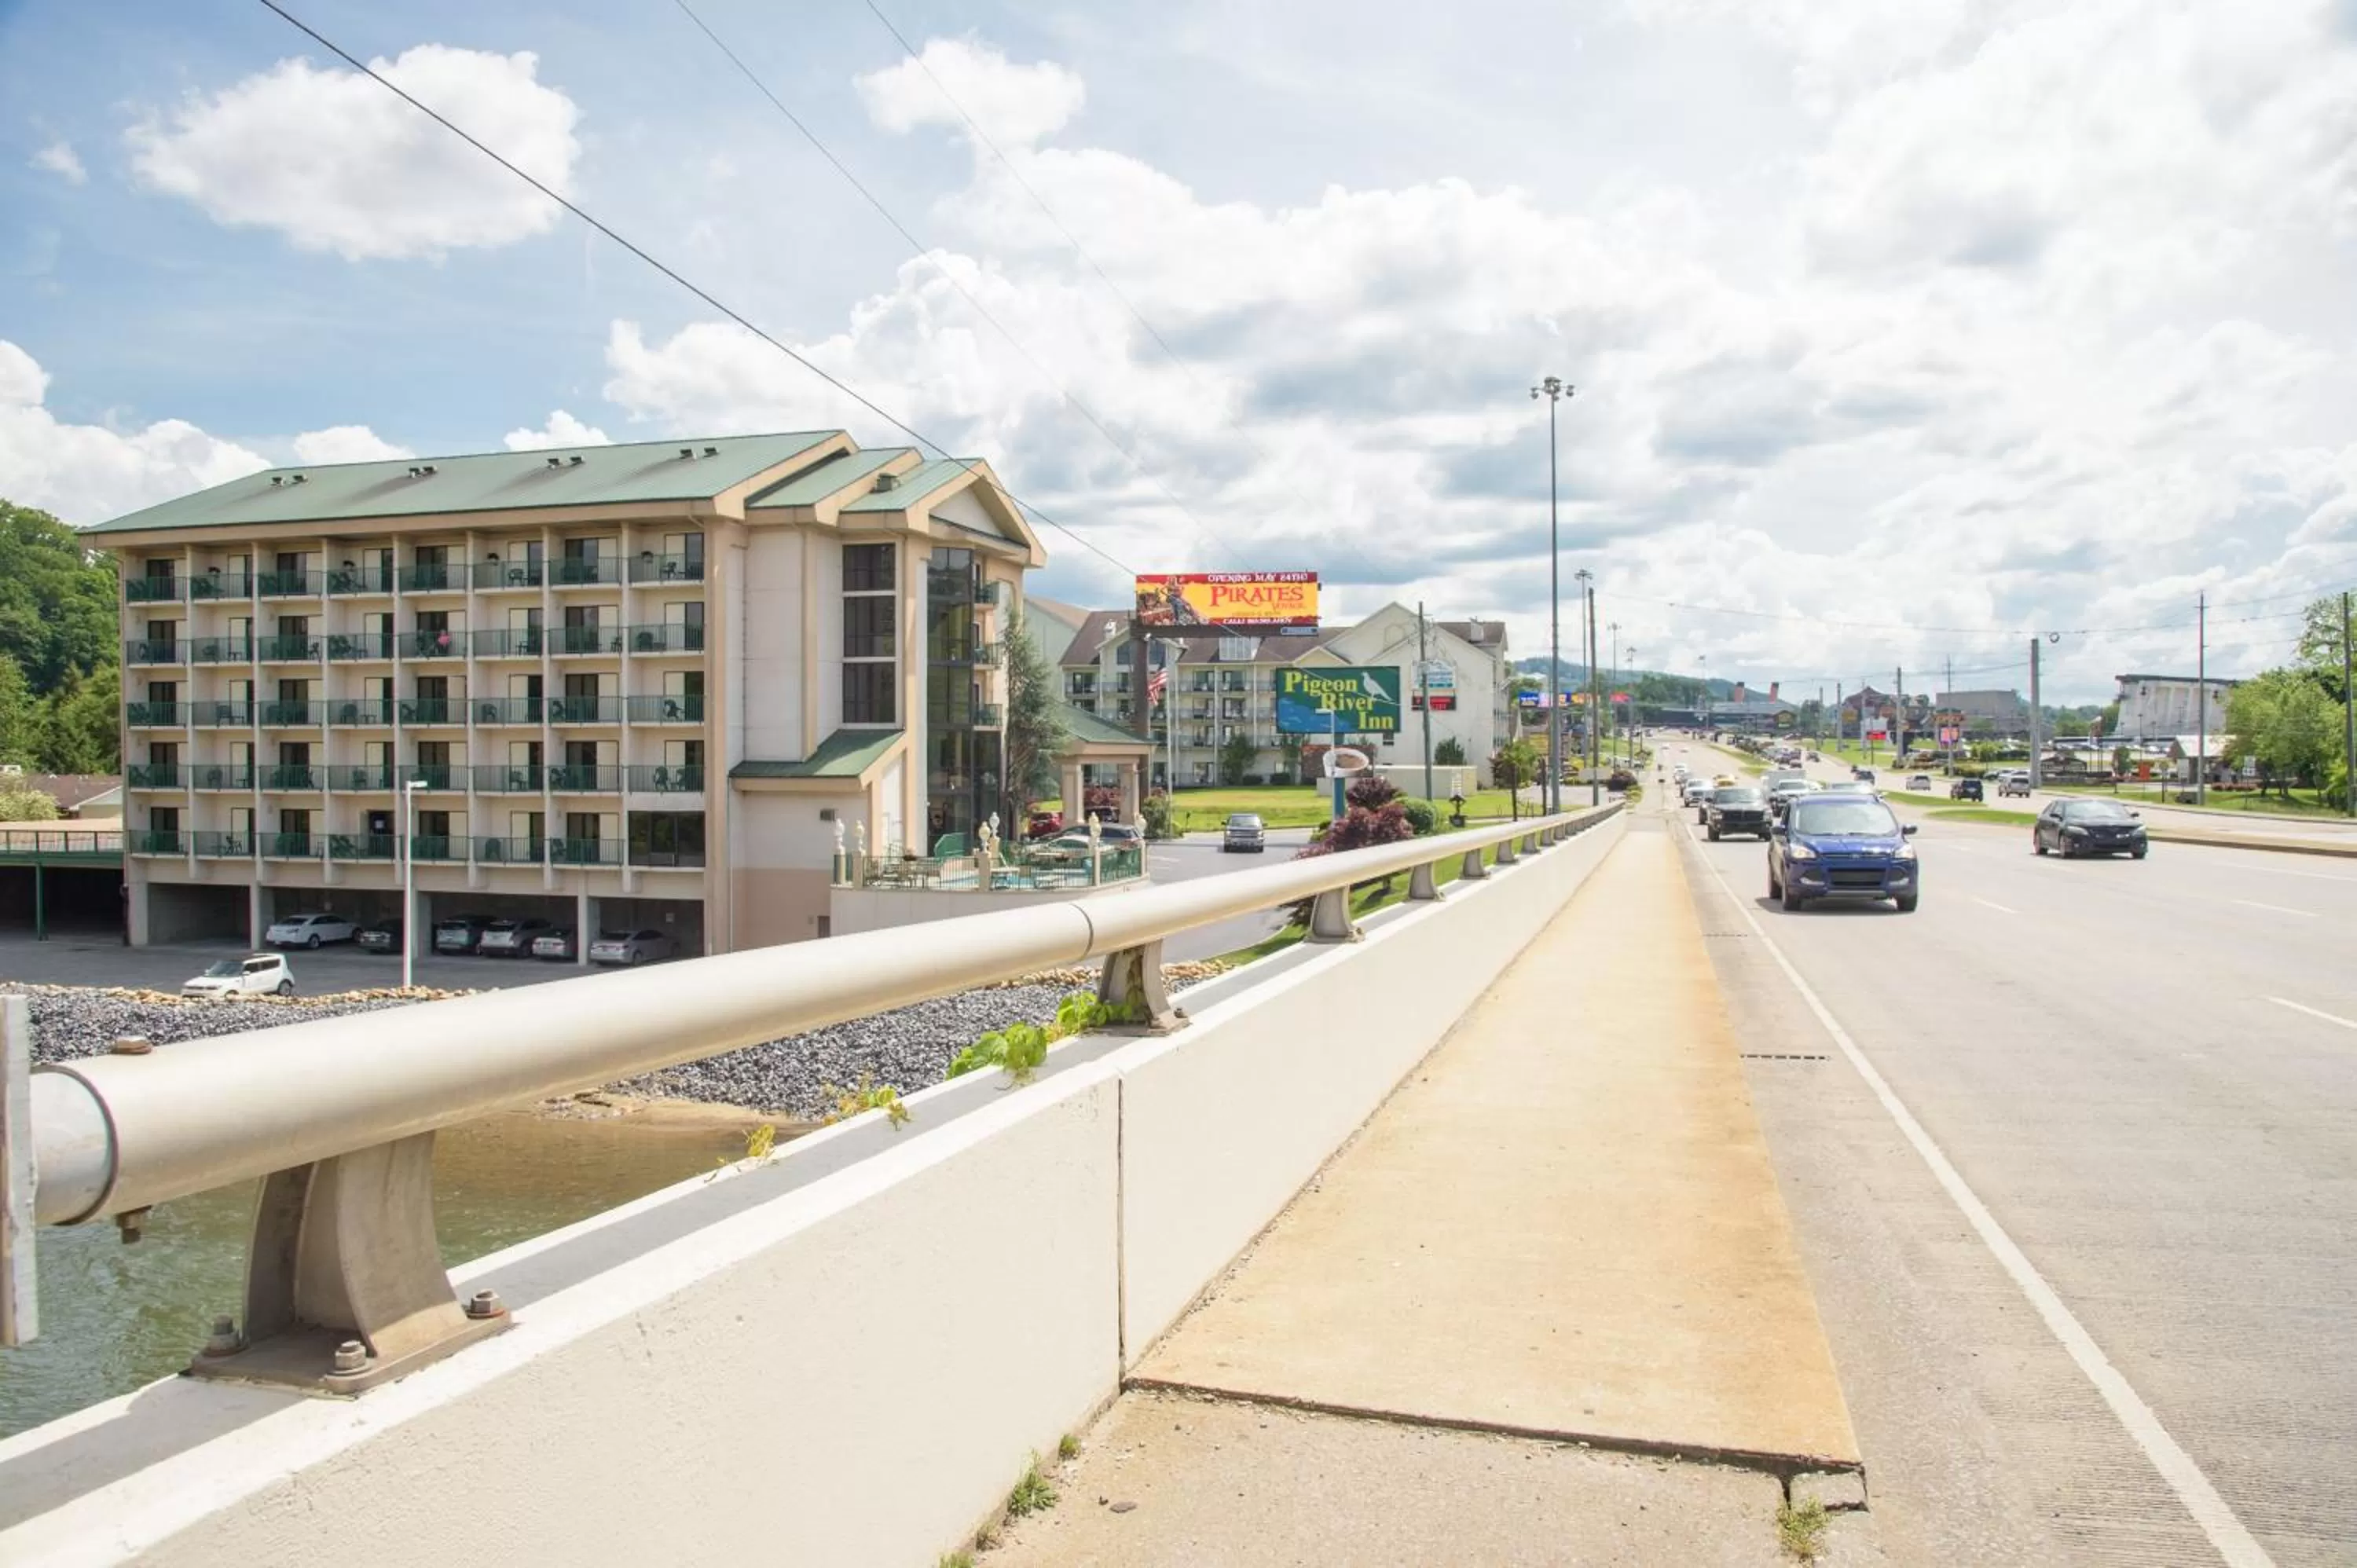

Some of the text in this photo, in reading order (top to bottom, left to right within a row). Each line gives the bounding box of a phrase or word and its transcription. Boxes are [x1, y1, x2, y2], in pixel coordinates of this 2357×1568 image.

[1208, 574, 1252, 583] OPENING
[1255, 573, 1277, 582] MAY
[1209, 585, 1304, 607] PIRATES
[1285, 671, 1358, 697] Pigeon
[1320, 692, 1374, 711] River
[1358, 711, 1394, 730] Inn
